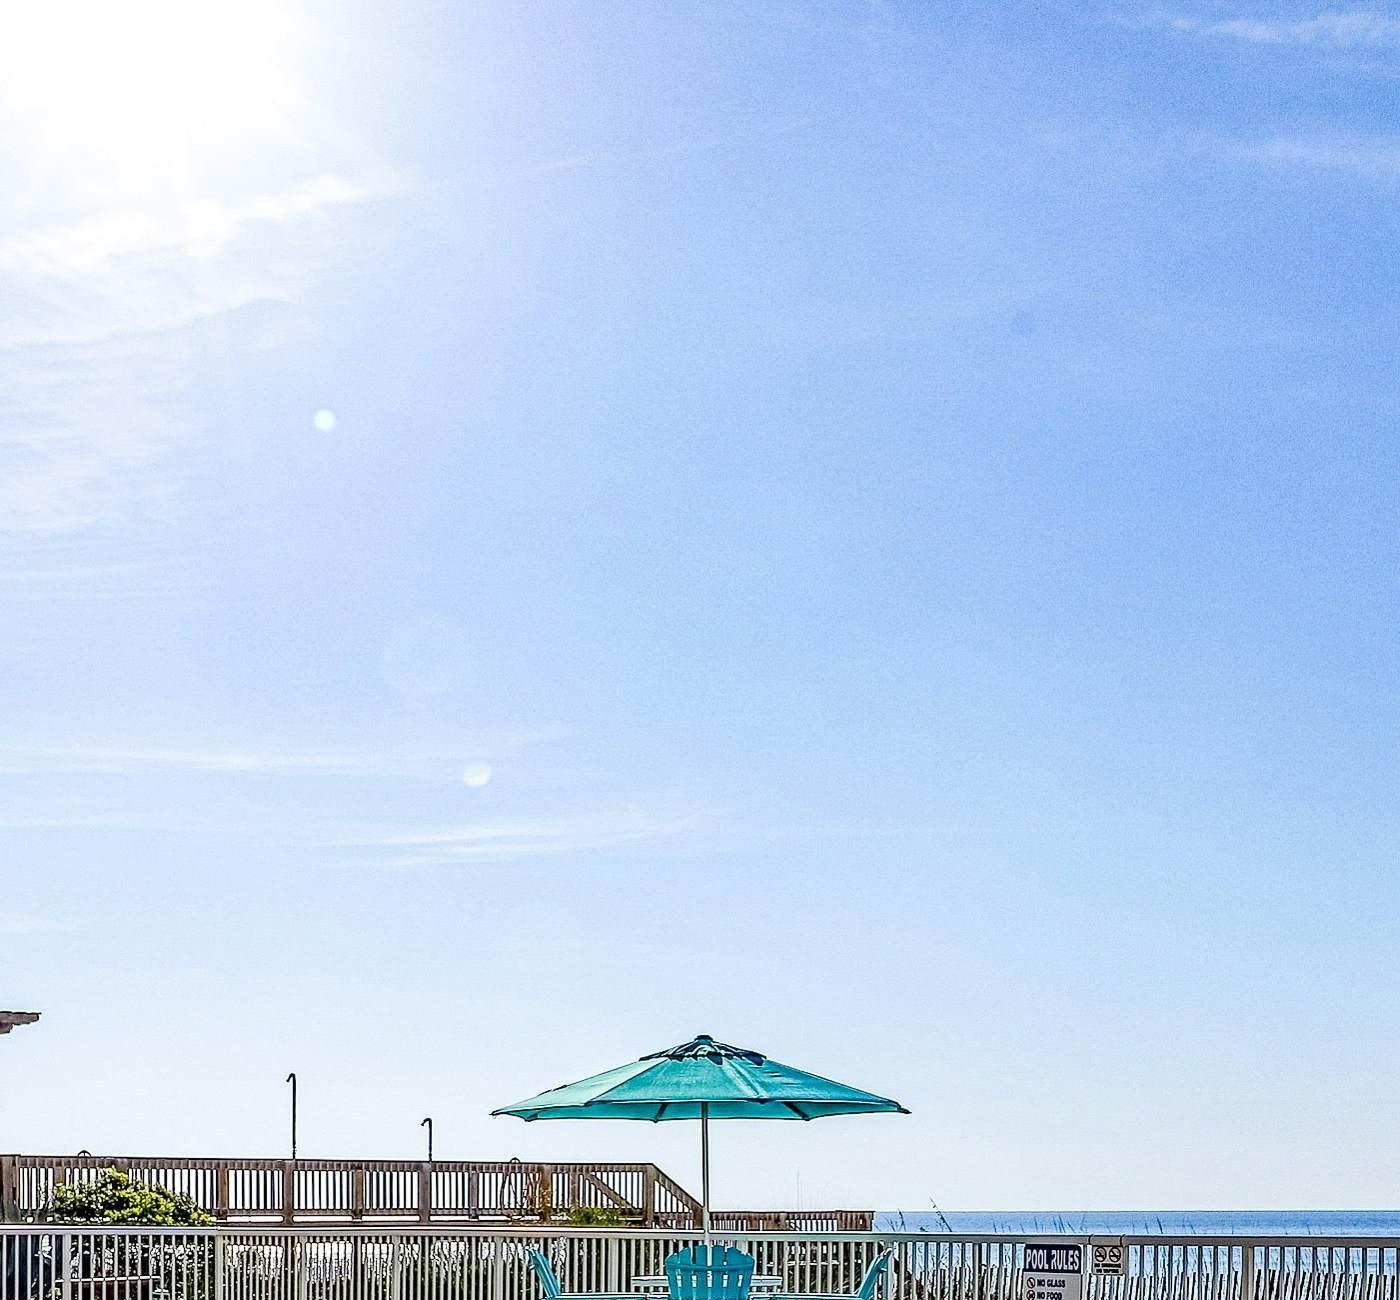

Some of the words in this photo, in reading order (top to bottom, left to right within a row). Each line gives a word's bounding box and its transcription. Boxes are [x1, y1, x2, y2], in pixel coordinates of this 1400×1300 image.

[1025, 1249, 1049, 1270] POOL
[1051, 1249, 1080, 1271] RULES
[1037, 1279, 1045, 1287] NO
[1046, 1279, 1066, 1288] GLASS
[1037, 1291, 1045, 1300] NO
[1046, 1292, 1063, 1300] FOOD
